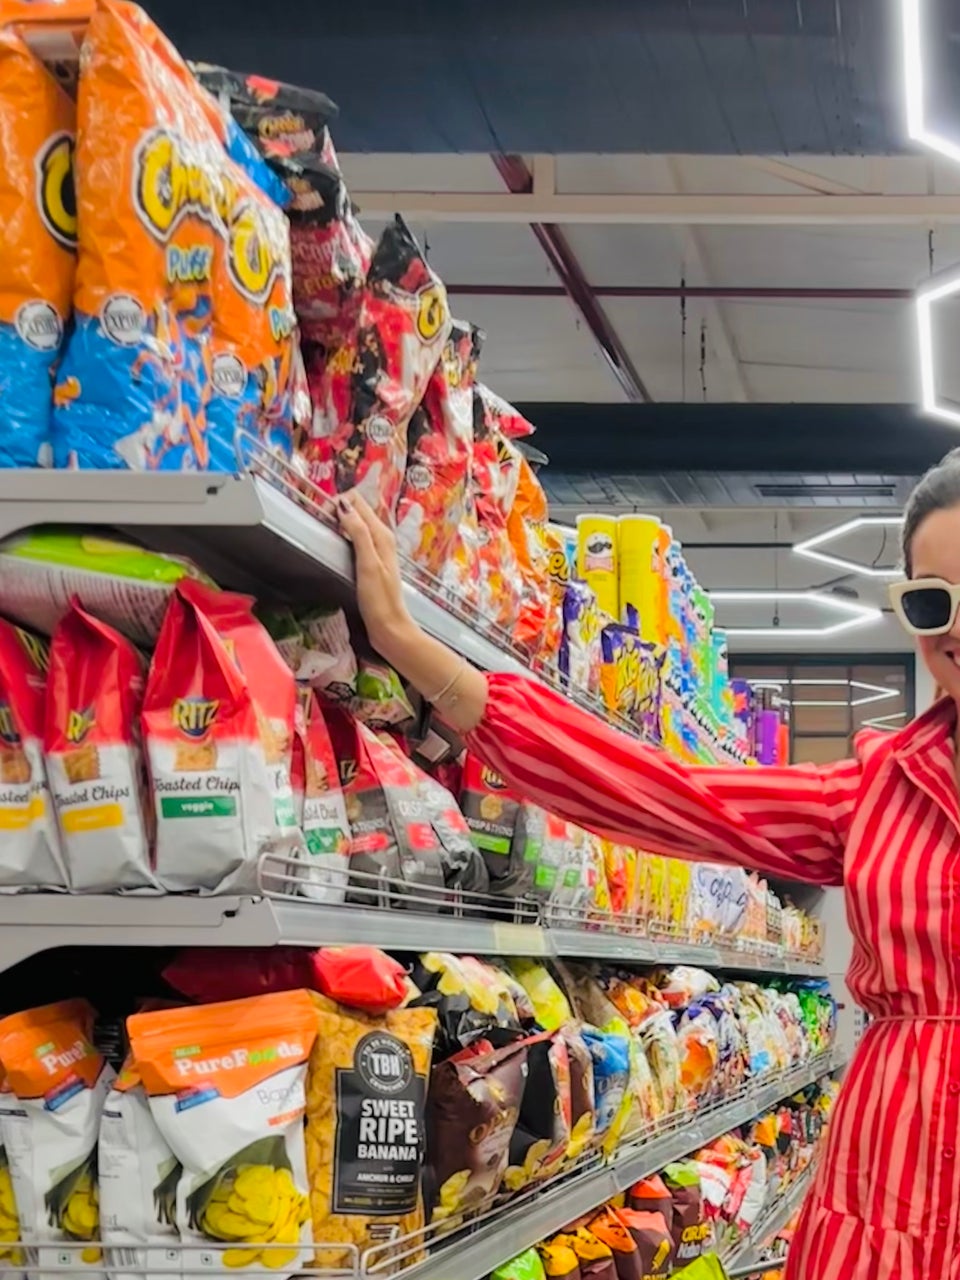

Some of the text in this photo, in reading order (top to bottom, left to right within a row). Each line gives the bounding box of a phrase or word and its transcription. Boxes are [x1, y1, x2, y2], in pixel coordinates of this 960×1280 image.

[173, 699, 219, 730] RITZ
[92, 785, 130, 802] Chips
[155, 778, 201, 793] Toasted
[181, 801, 214, 812] veggie
[174, 1041, 305, 1076] PureFoods
[371, 1053, 400, 1076] TBH
[362, 1099, 415, 1118] SWEET
[359, 1117, 418, 1144] RIPE
[357, 1144, 417, 1160] BANANA
